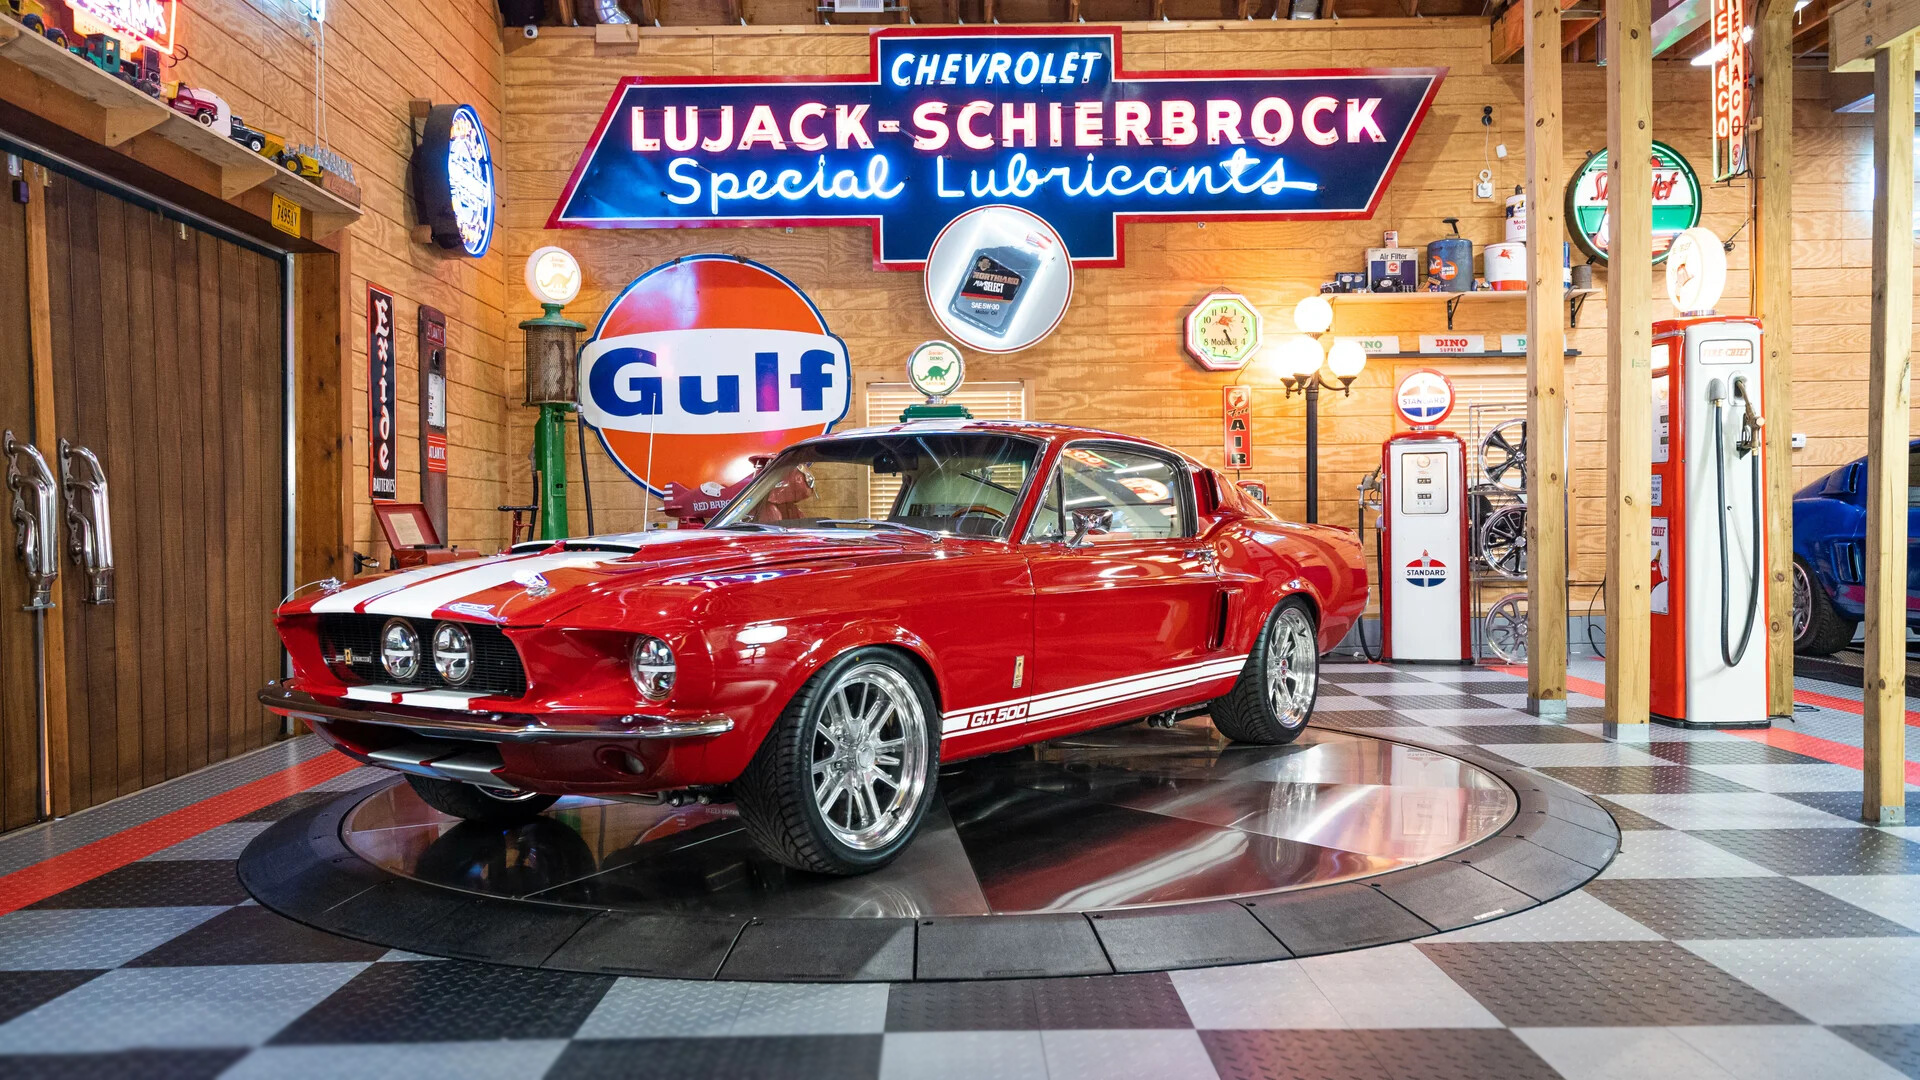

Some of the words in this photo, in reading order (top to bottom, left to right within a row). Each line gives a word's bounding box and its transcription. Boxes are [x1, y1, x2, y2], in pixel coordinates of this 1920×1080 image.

[891, 51, 1103, 87] CHEVROLET
[1716, 0, 1729, 138] EACO
[667, 154, 905, 215] Special
[936, 147, 1319, 199] Lubricants
[1380, 252, 1389, 260] Air
[1391, 252, 1407, 260] Filter
[1430, 259, 1441, 270] AC
[1221, 306, 1228, 314] 12
[1204, 338, 1209, 346] 8
[1435, 338, 1469, 347] DINO
[588, 346, 836, 418] Gulf
[1230, 418, 1247, 465] AIR
[373, 476, 396, 494] BATTERIES
[693, 500, 709, 512] RED
